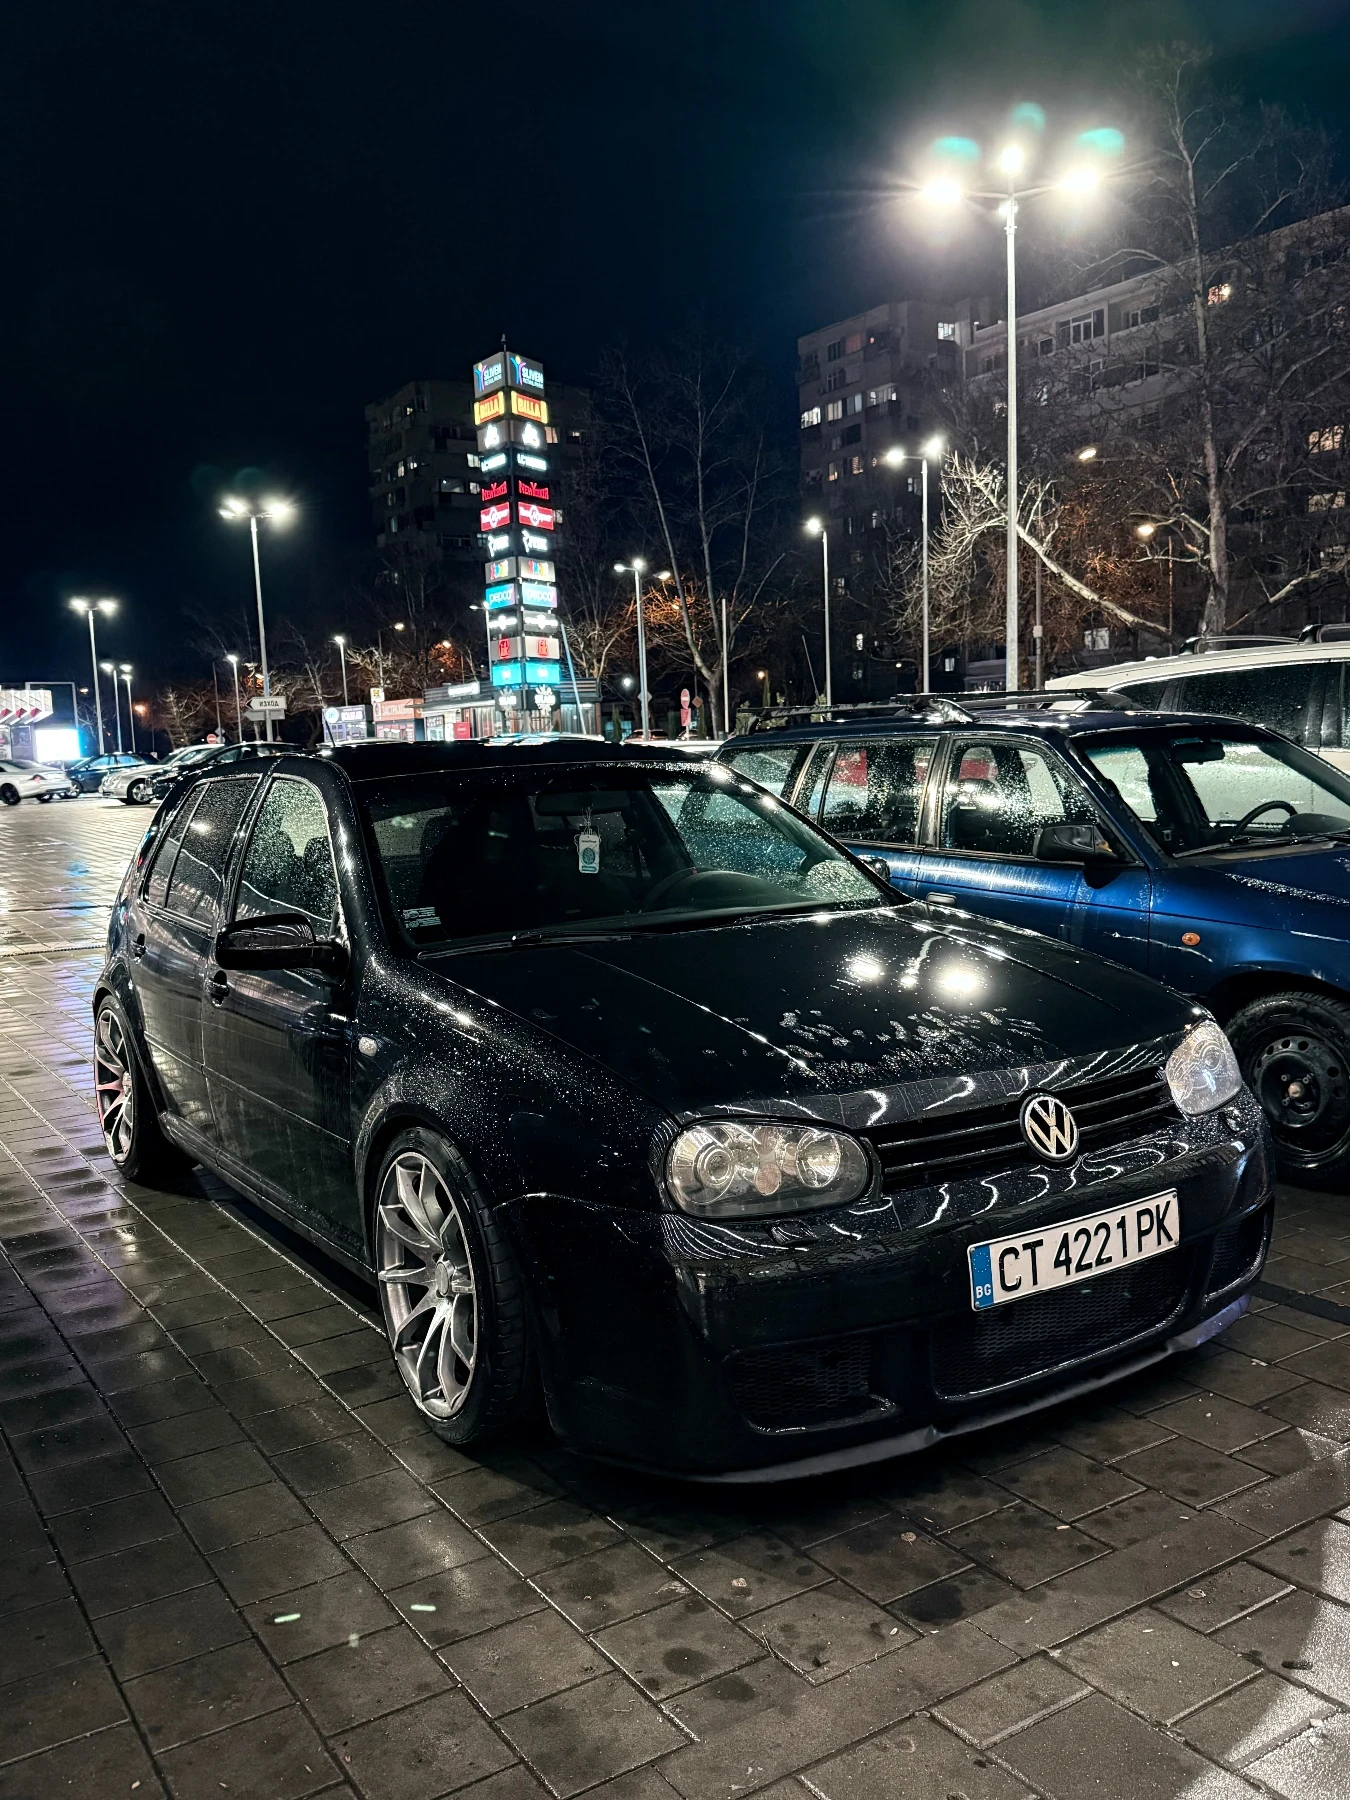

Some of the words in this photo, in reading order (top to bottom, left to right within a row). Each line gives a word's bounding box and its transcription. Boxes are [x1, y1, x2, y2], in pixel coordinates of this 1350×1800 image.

[480, 398, 500, 420] BILLA
[517, 397, 541, 418] BILLA
[489, 589, 512, 605] pepco
[527, 588, 554, 603] pepco
[998, 1238, 1044, 1292] CT
[1053, 1215, 1128, 1276] 4221
[1136, 1200, 1174, 1253] PK
[975, 1283, 992, 1299] BG
